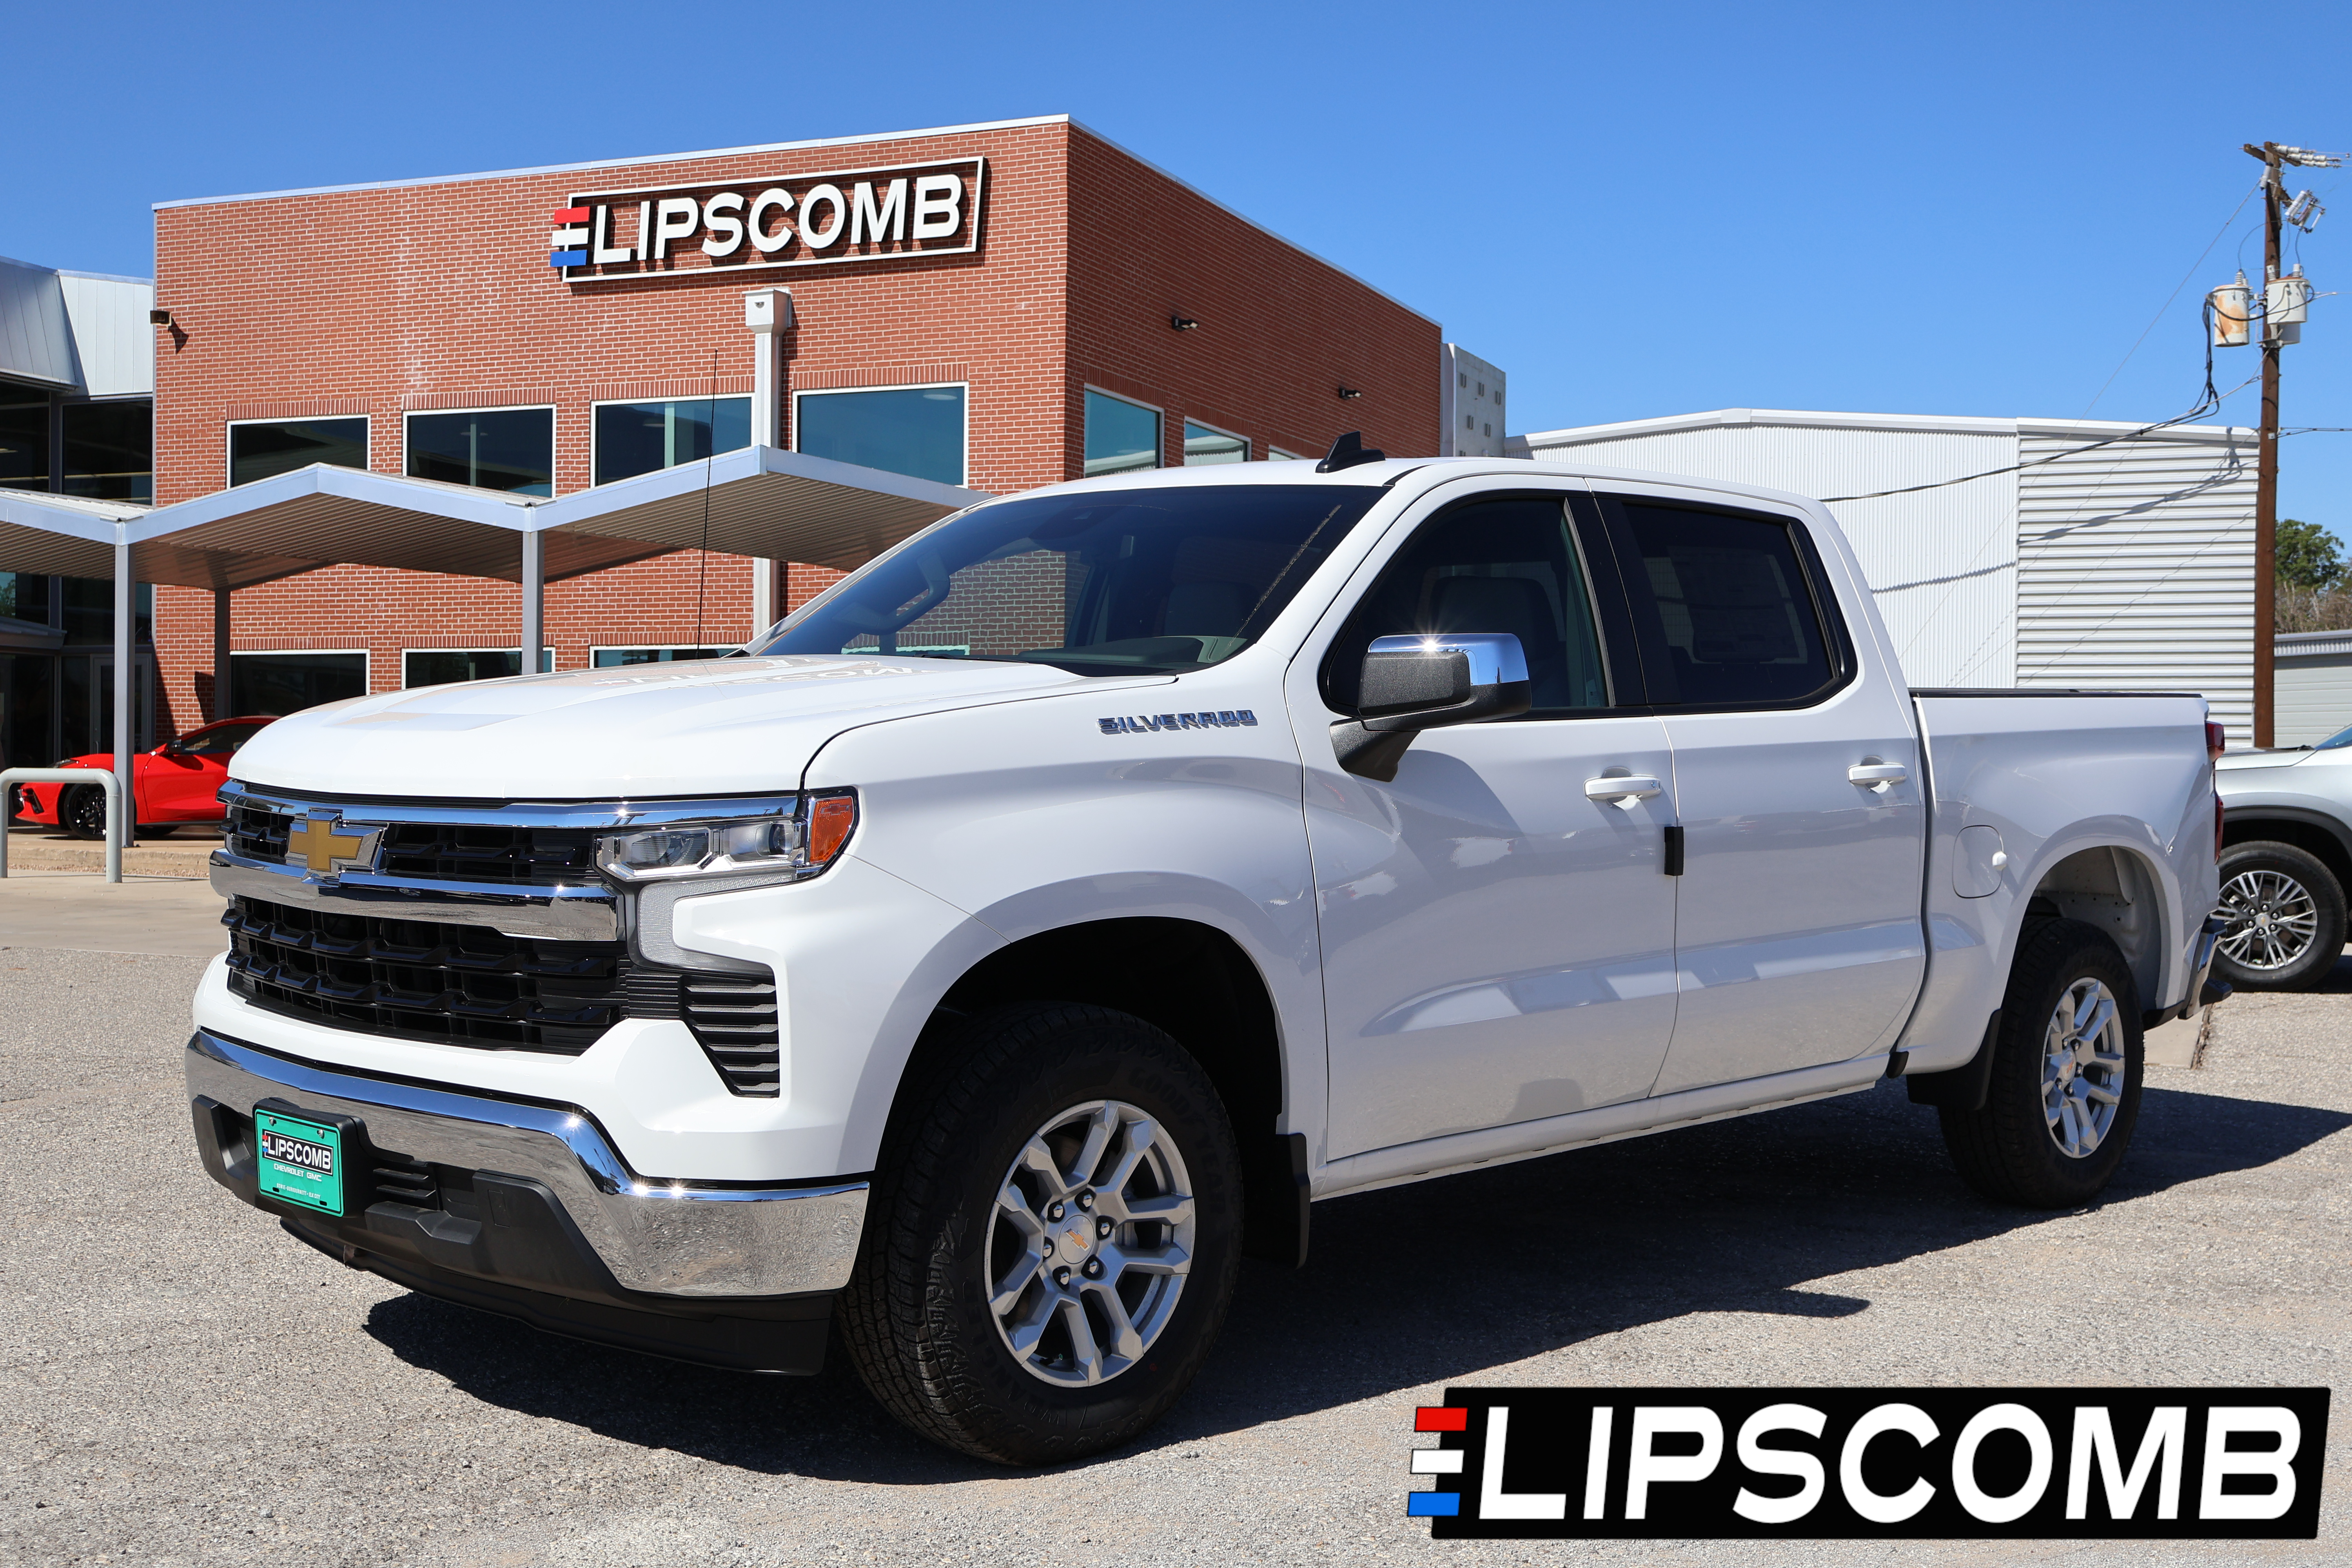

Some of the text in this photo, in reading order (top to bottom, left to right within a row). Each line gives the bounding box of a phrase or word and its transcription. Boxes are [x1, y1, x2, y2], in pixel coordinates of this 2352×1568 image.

[593, 174, 963, 264] LIPSCOMB
[1096, 710, 1255, 731] SILVERADO
[268, 1136, 331, 1169] LIPSCOMB
[1128, 1066, 1226, 1215] GOODYEAR
[274, 1163, 322, 1182] CHEVROLET GMC
